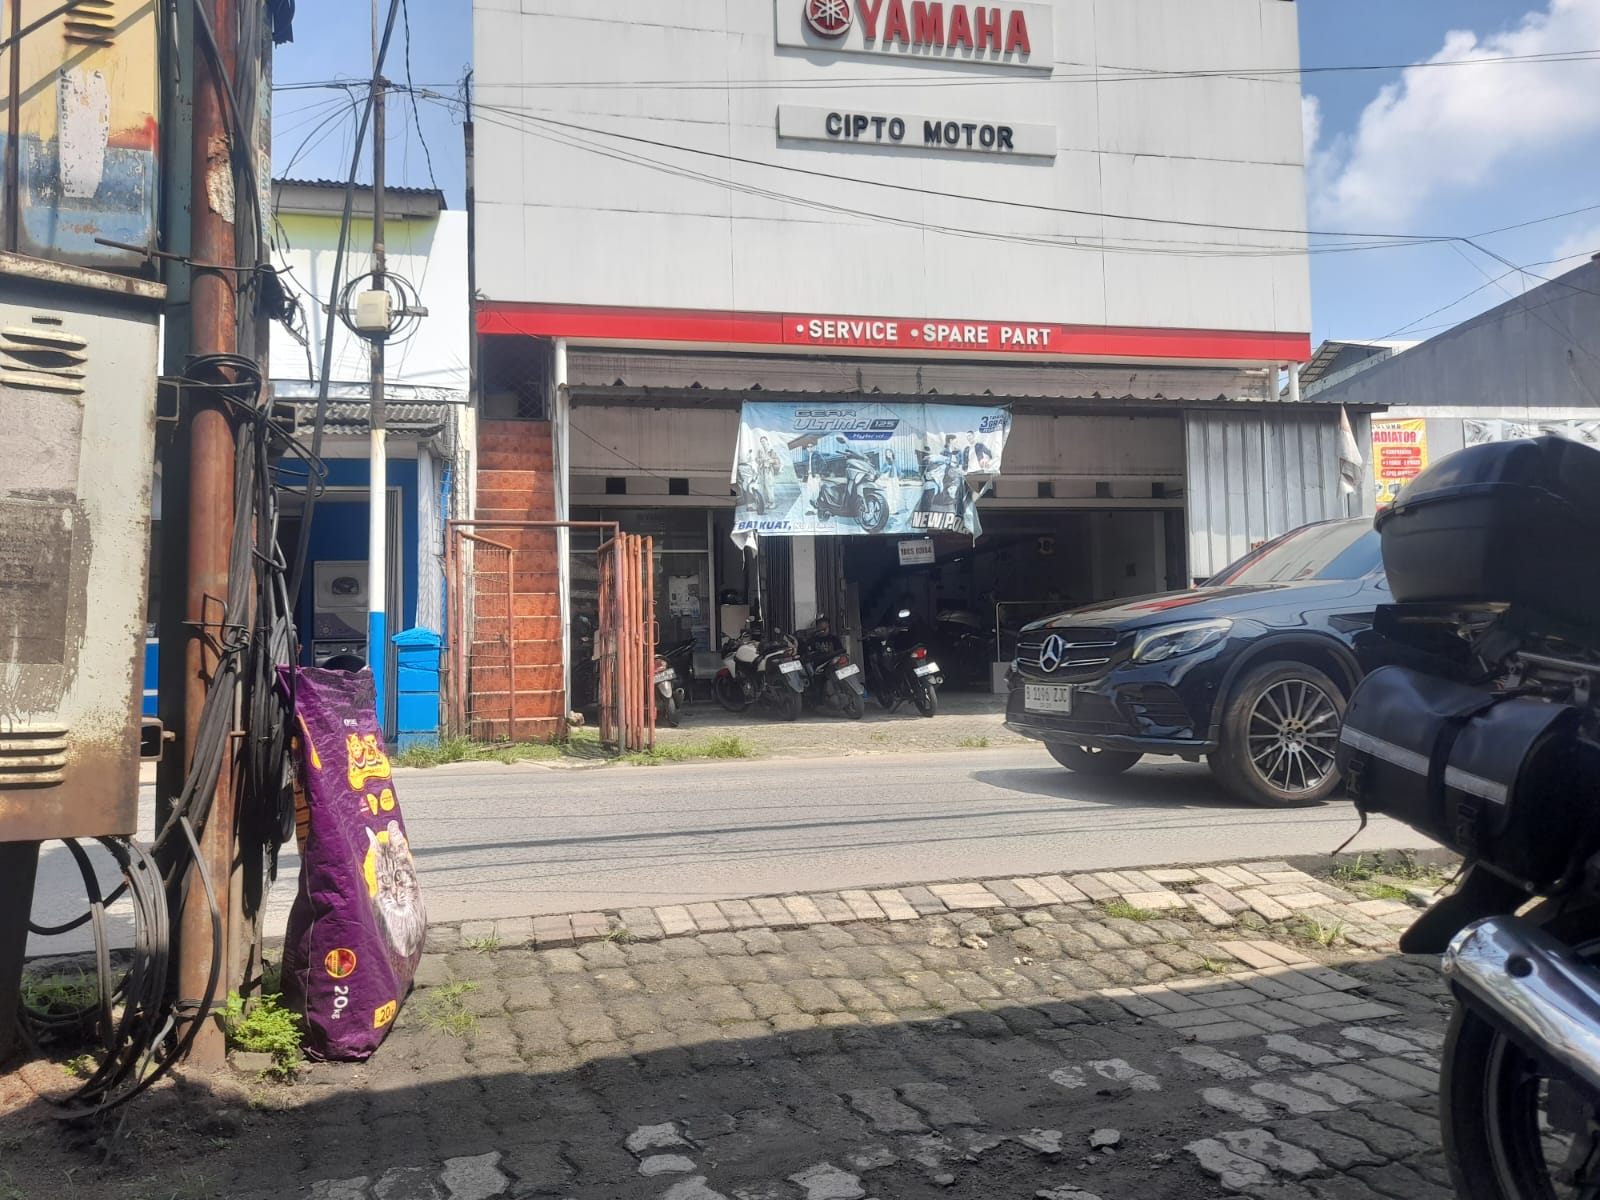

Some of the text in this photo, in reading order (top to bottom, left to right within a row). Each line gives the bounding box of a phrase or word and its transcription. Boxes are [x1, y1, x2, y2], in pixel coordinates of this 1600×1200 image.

[859, 0, 1031, 54] YAMAHA
[825, 112, 1014, 149] CIPTO MOTOR
[809, 319, 1051, 346] SERVICE SPARE PART
[795, 409, 856, 418] GEAR
[794, 418, 870, 431] ULTIMA
[980, 415, 989, 428] 3
[1371, 431, 1417, 443] ADIATOR
[912, 511, 943, 529] NEW
